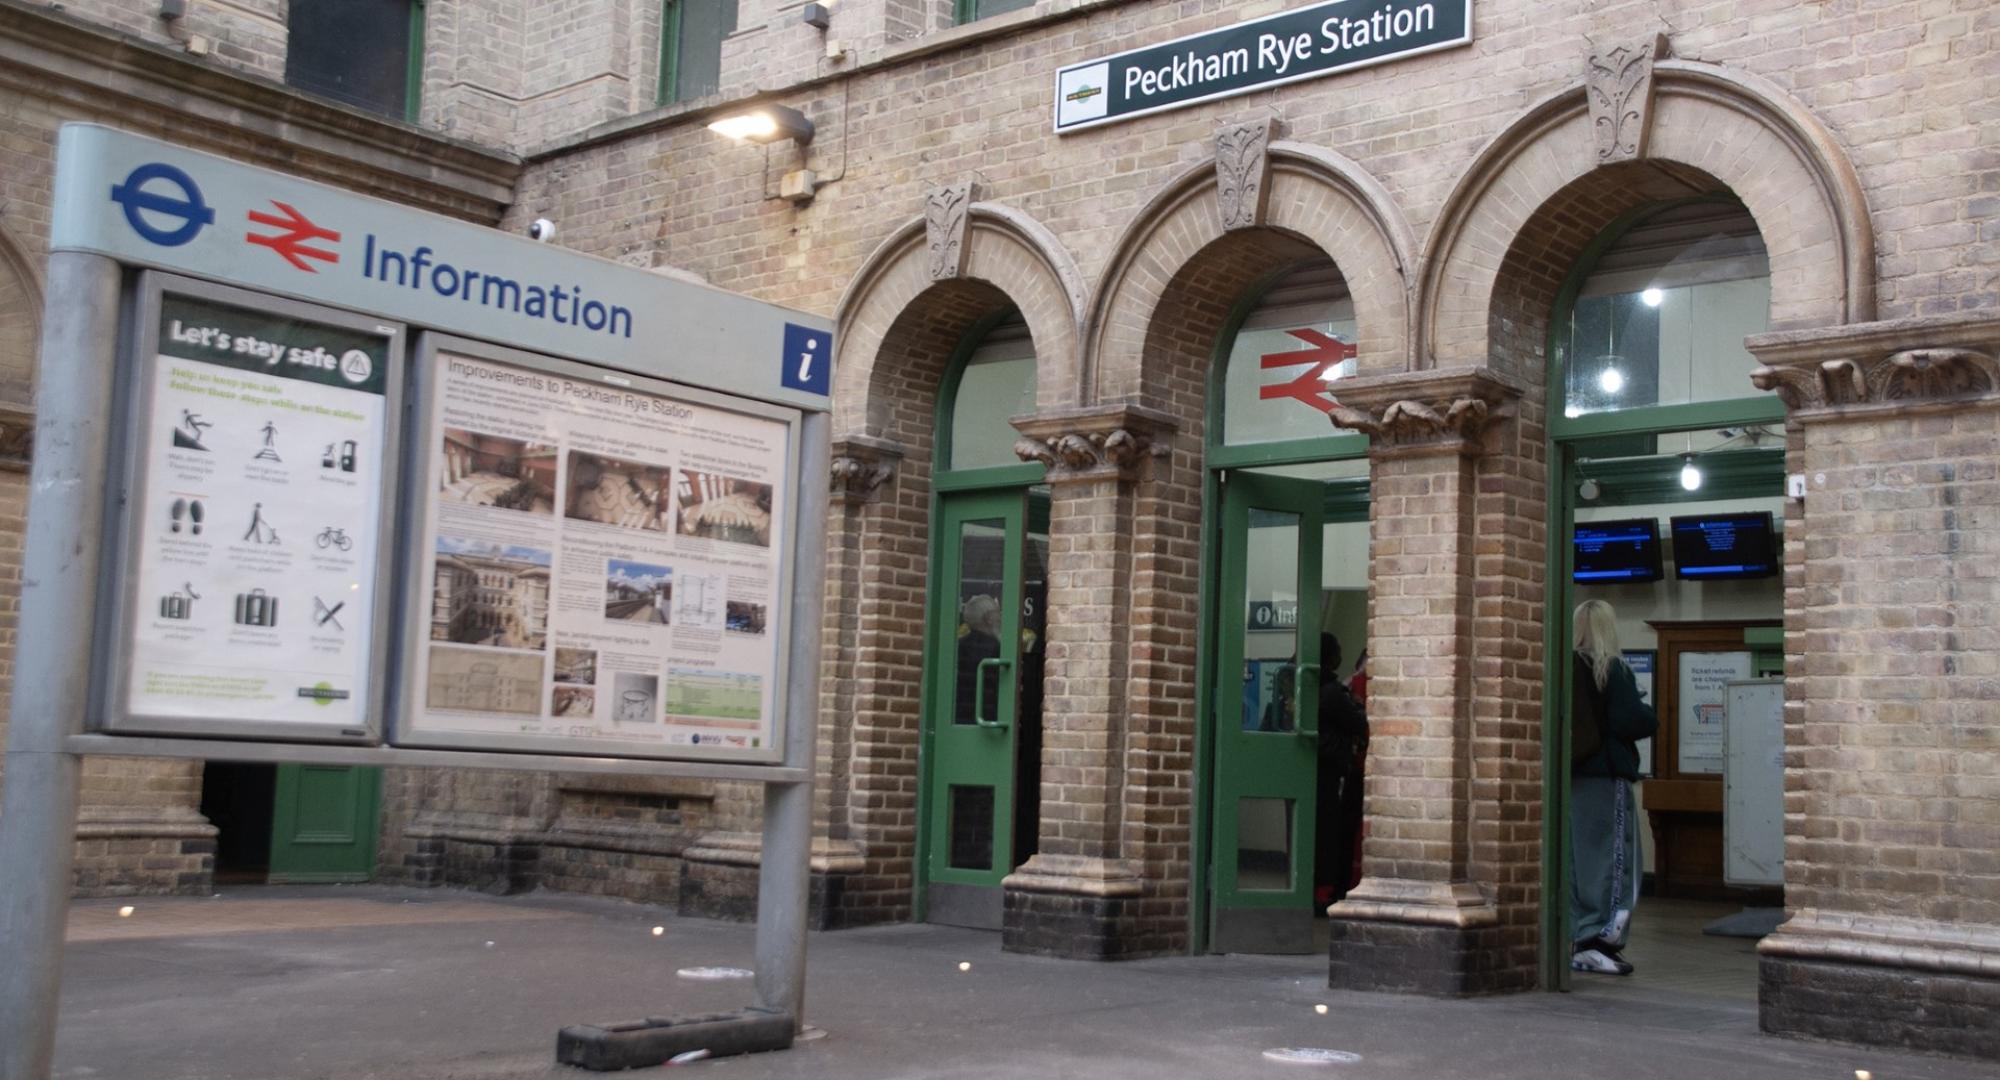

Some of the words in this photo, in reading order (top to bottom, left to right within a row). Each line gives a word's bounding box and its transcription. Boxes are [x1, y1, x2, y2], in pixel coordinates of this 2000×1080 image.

[1125, 47, 1248, 100] Peckham
[1258, 31, 1312, 74] Rye
[1320, 1, 1434, 54] Station
[362, 234, 632, 338] Information
[171, 320, 232, 350] Let's
[234, 336, 286, 364] stay
[289, 347, 338, 370] safe
[448, 358, 544, 392] Improvements
[548, 380, 560, 393] to
[564, 381, 622, 406] Peckham
[624, 394, 650, 414] Rye
[652, 399, 692, 420] Station
